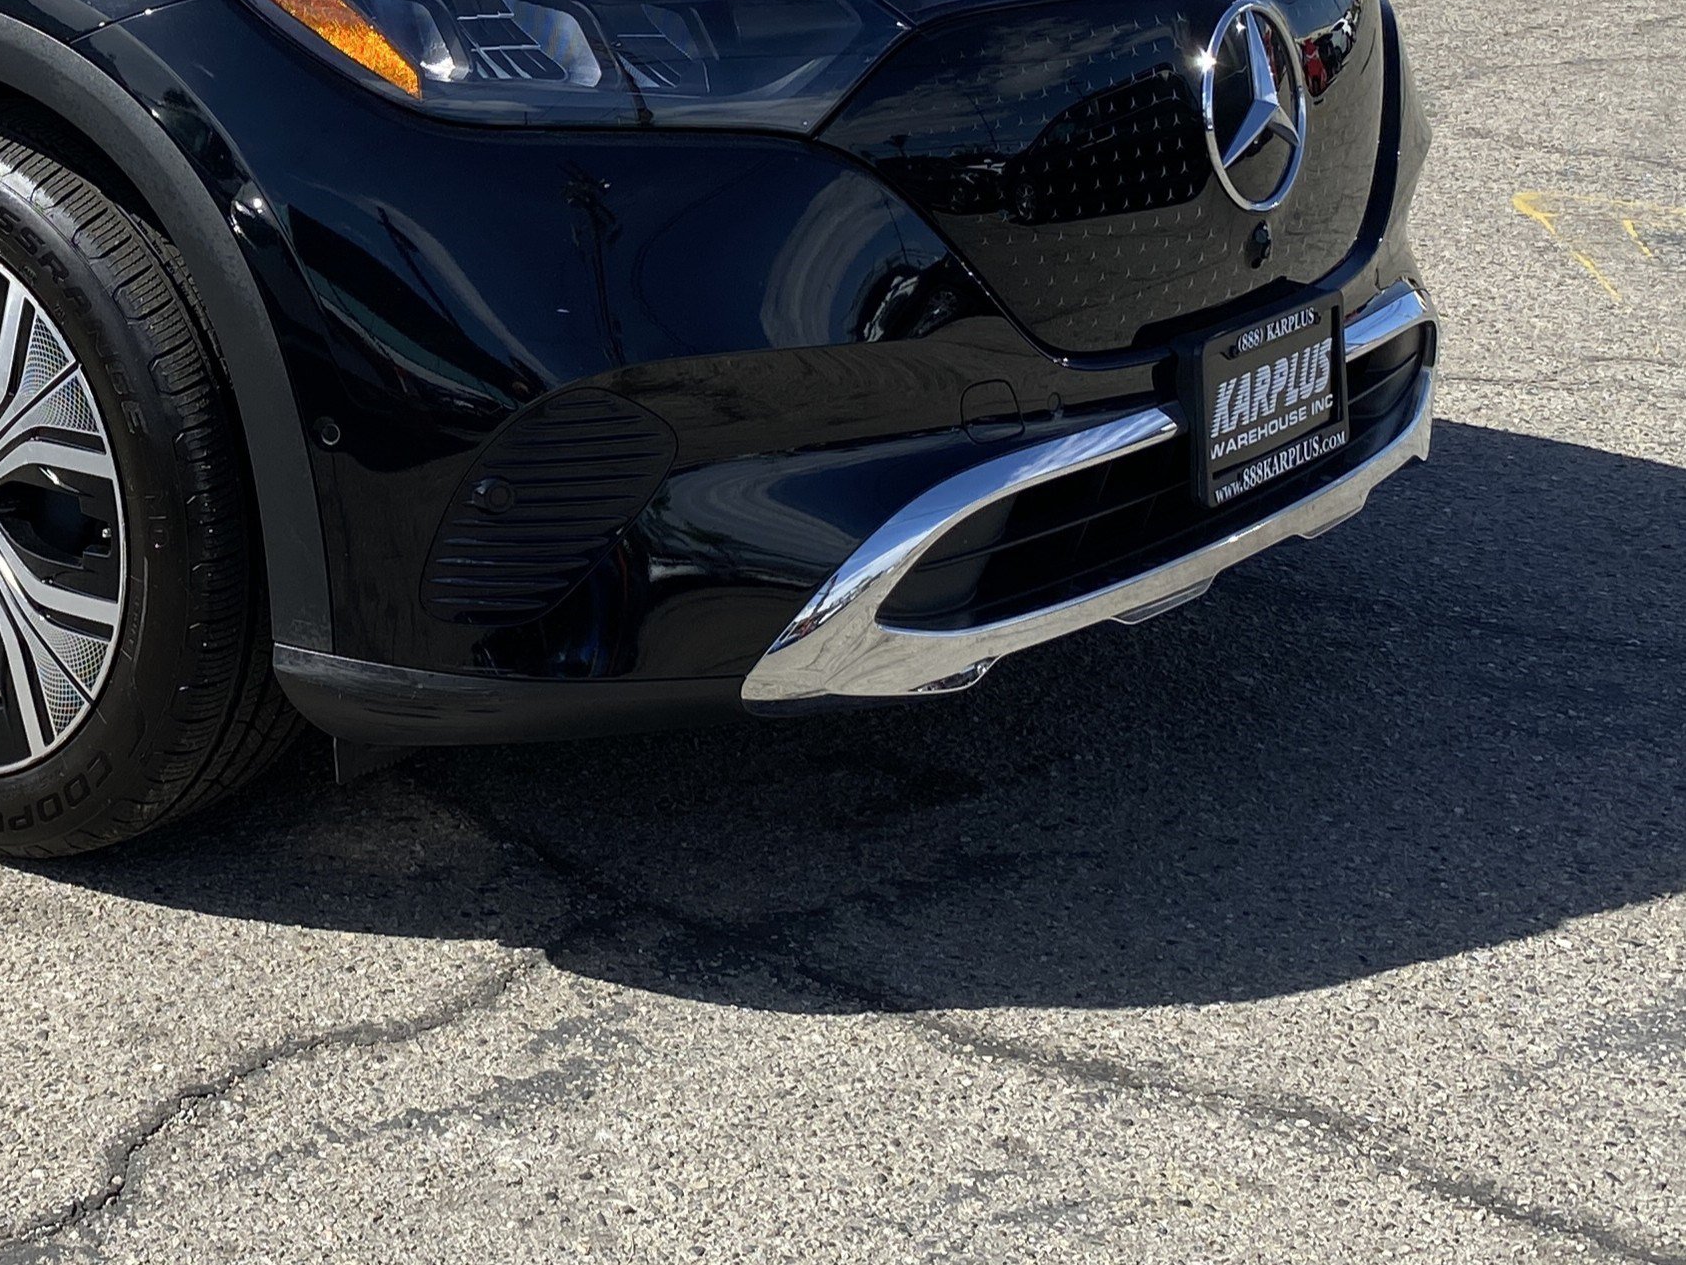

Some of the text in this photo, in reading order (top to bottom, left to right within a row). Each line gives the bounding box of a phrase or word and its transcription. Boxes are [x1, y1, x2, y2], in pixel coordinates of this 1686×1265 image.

[1238, 307, 1314, 353] (888) KARPLUS
[1210, 337, 1333, 439] KARPLUS
[1210, 394, 1334, 460] WAREHOUSE INC
